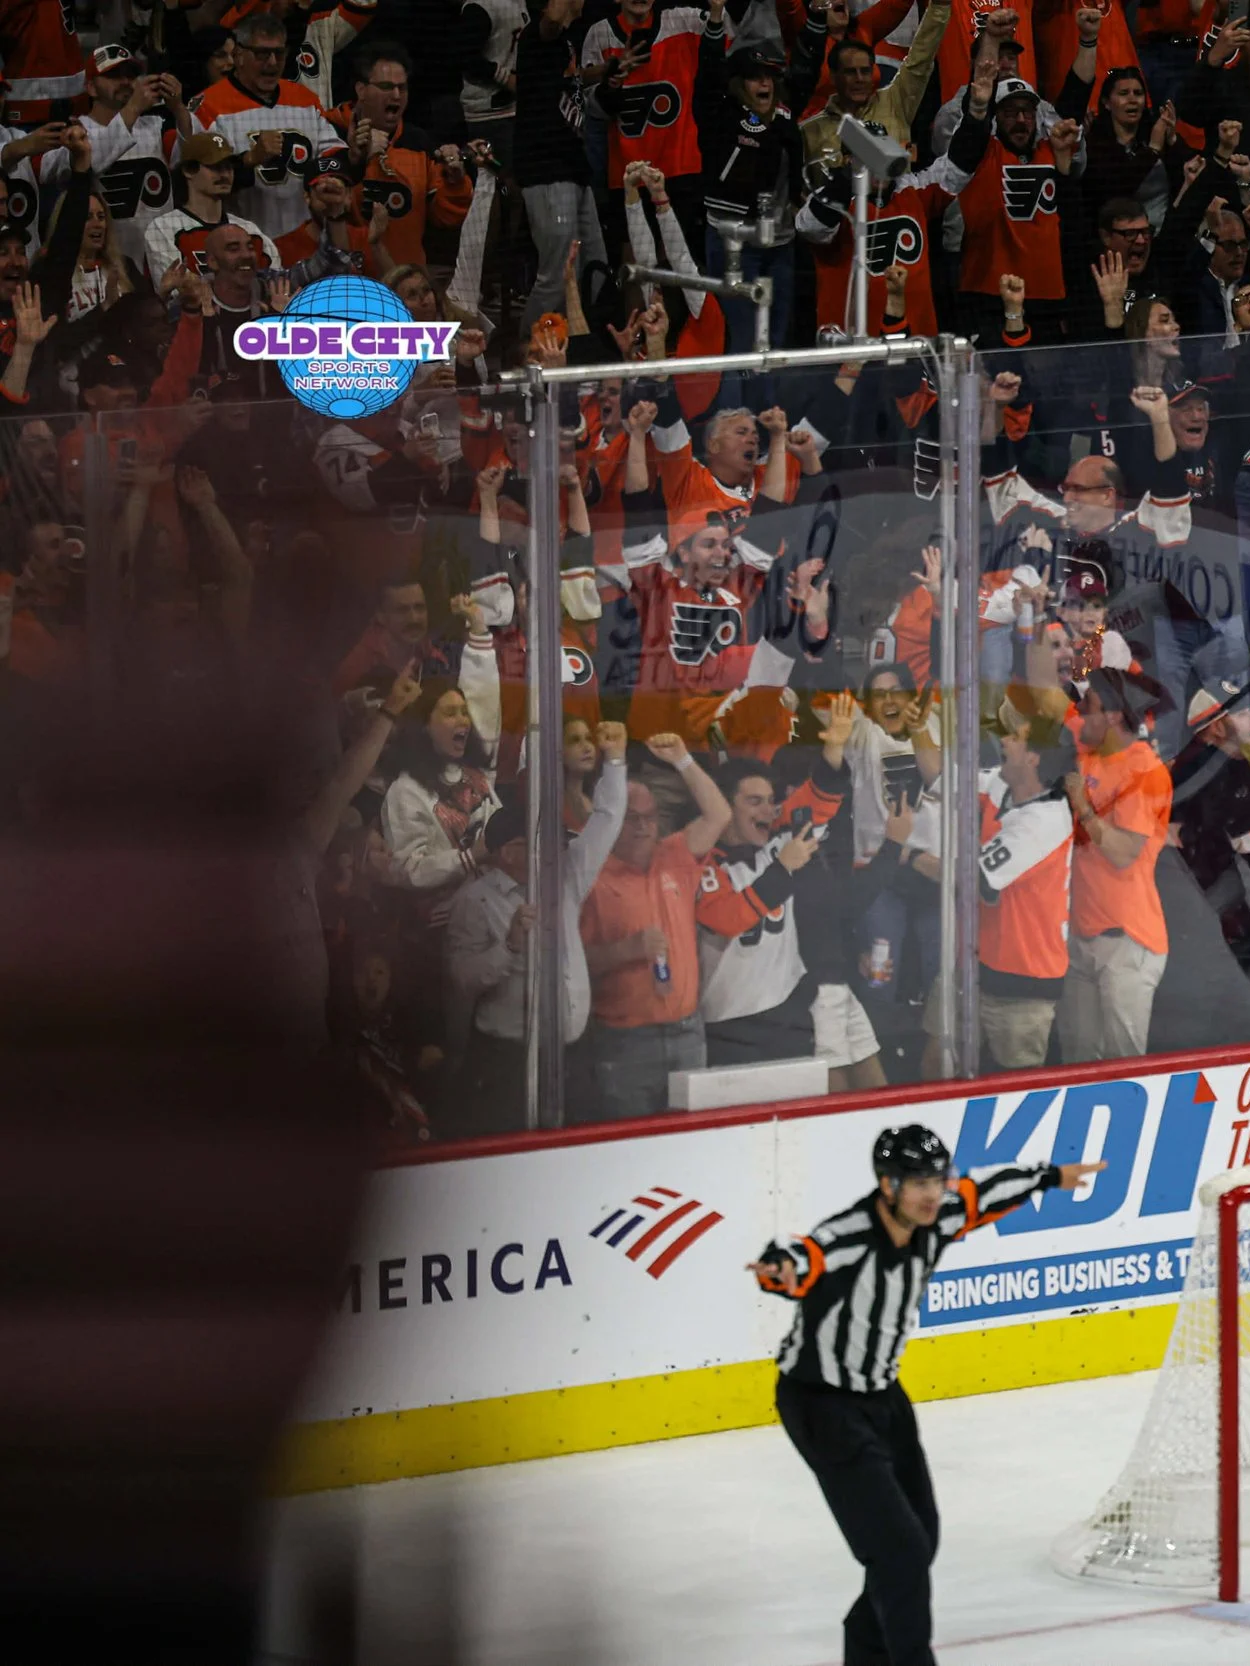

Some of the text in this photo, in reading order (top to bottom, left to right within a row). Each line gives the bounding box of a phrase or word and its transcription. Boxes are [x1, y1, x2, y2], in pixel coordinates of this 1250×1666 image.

[1100, 429, 1116, 457] 5
[947, 1072, 1218, 1238] KDI
[927, 1267, 1041, 1313] BRINGING
[1044, 1252, 1152, 1297] BUSINESS
[1154, 1250, 1174, 1281] &
